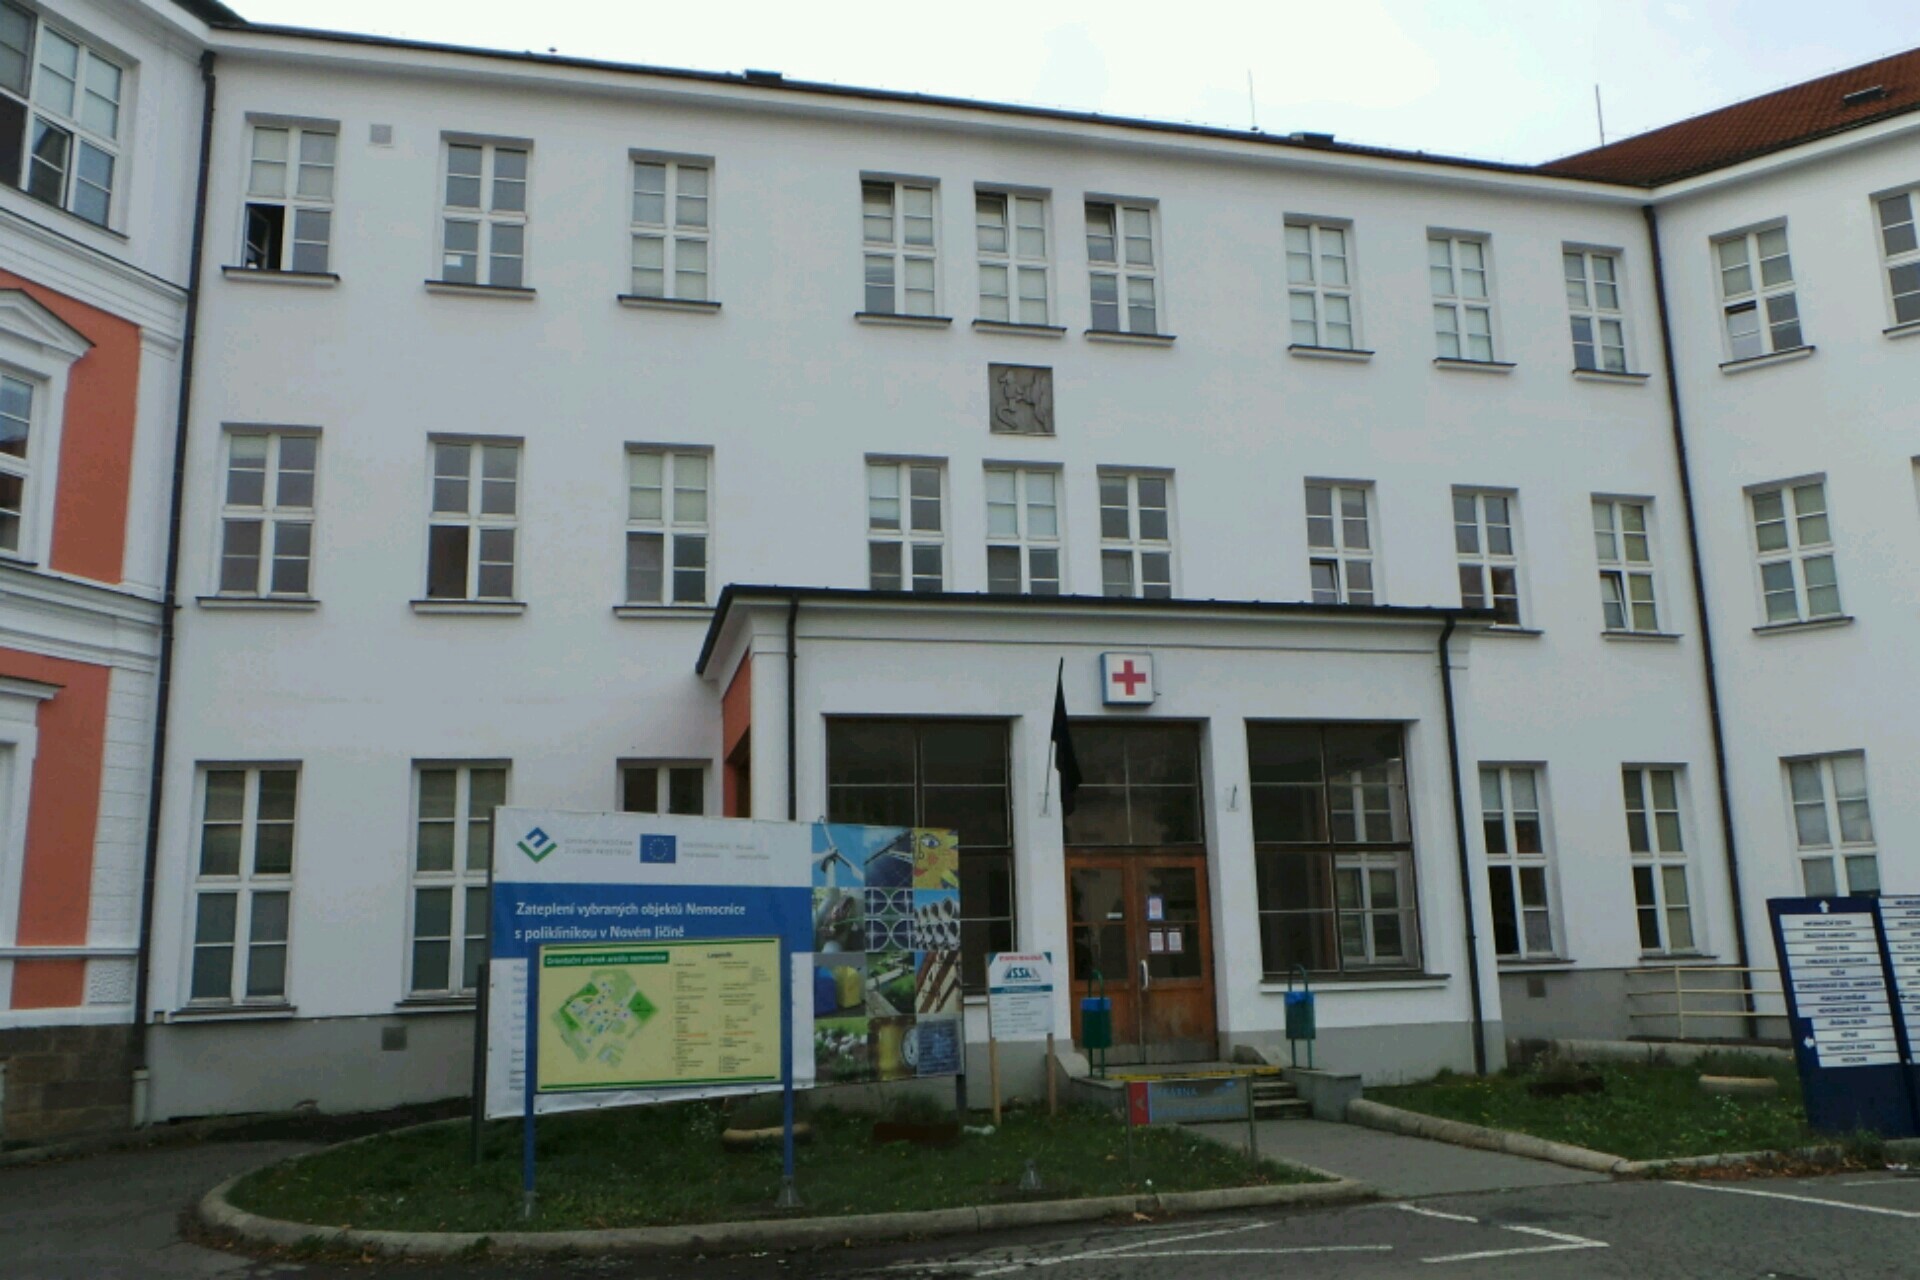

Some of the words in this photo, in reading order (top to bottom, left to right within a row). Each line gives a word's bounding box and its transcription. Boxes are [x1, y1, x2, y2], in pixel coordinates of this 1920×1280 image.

[515, 901, 575, 917] Zateplení
[578, 902, 638, 918] vybraných
[641, 901, 683, 917] objektů
[686, 902, 746, 916] Nemocnice
[514, 929, 521, 939] s
[525, 926, 597, 942] poliklinikou
[600, 929, 607, 938] v
[610, 925, 652, 938] Novém
[655, 925, 685, 940] Jičíně
